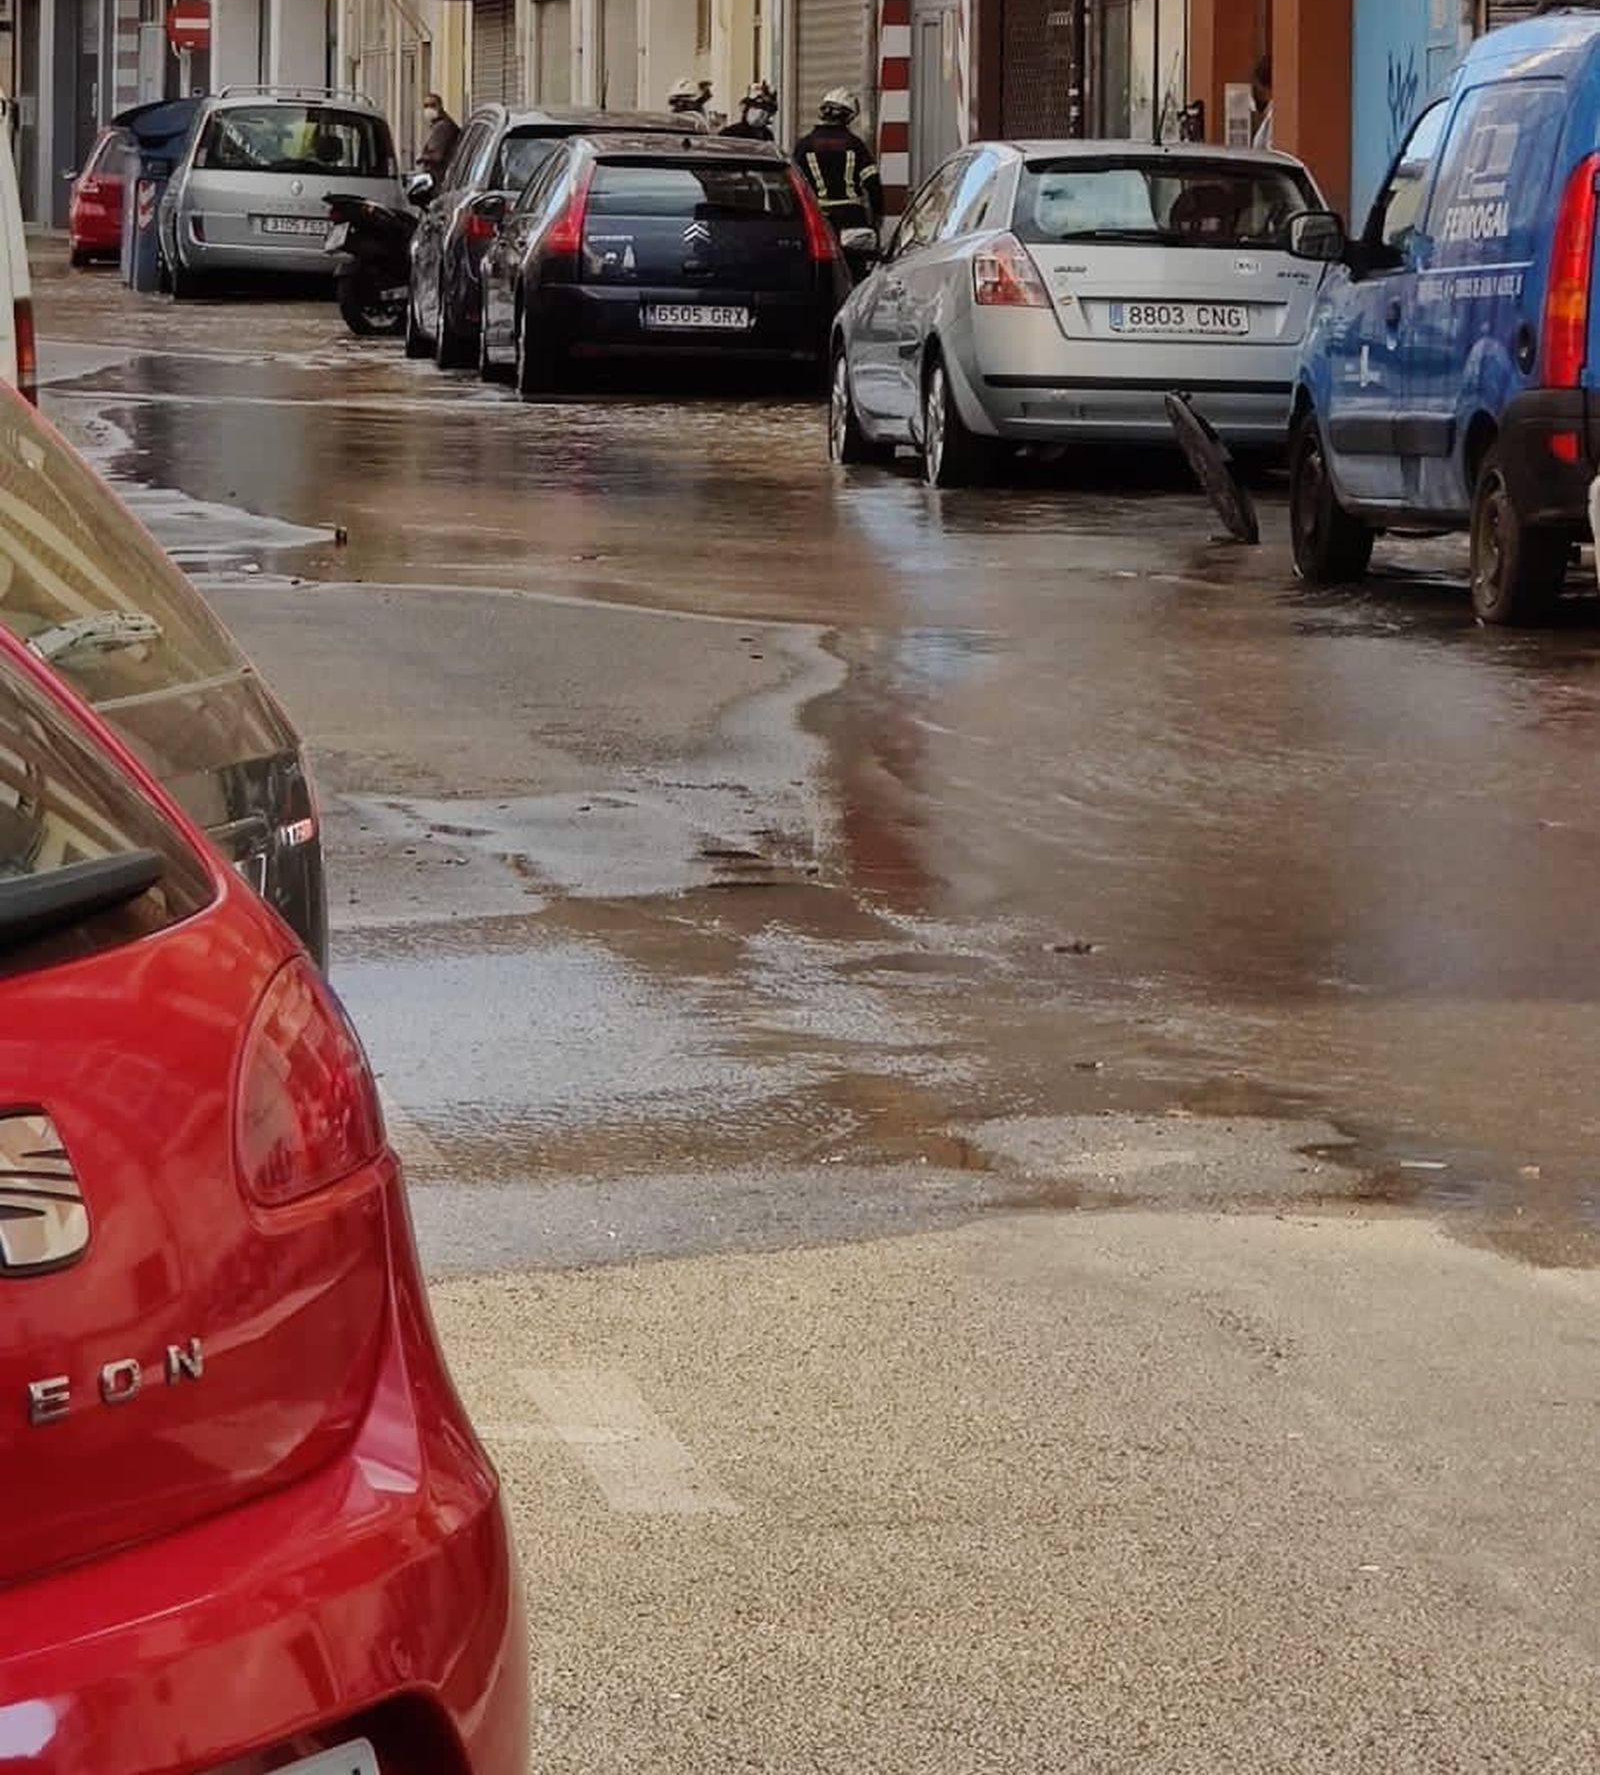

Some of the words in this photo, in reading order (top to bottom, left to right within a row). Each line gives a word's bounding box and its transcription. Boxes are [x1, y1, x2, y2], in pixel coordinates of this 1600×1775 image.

[1444, 203, 1510, 241] FERROGAL
[658, 307, 702, 323] 6505
[711, 308, 747, 325] GRX
[1129, 305, 1185, 326] 8803
[1196, 306, 1242, 328] CNG
